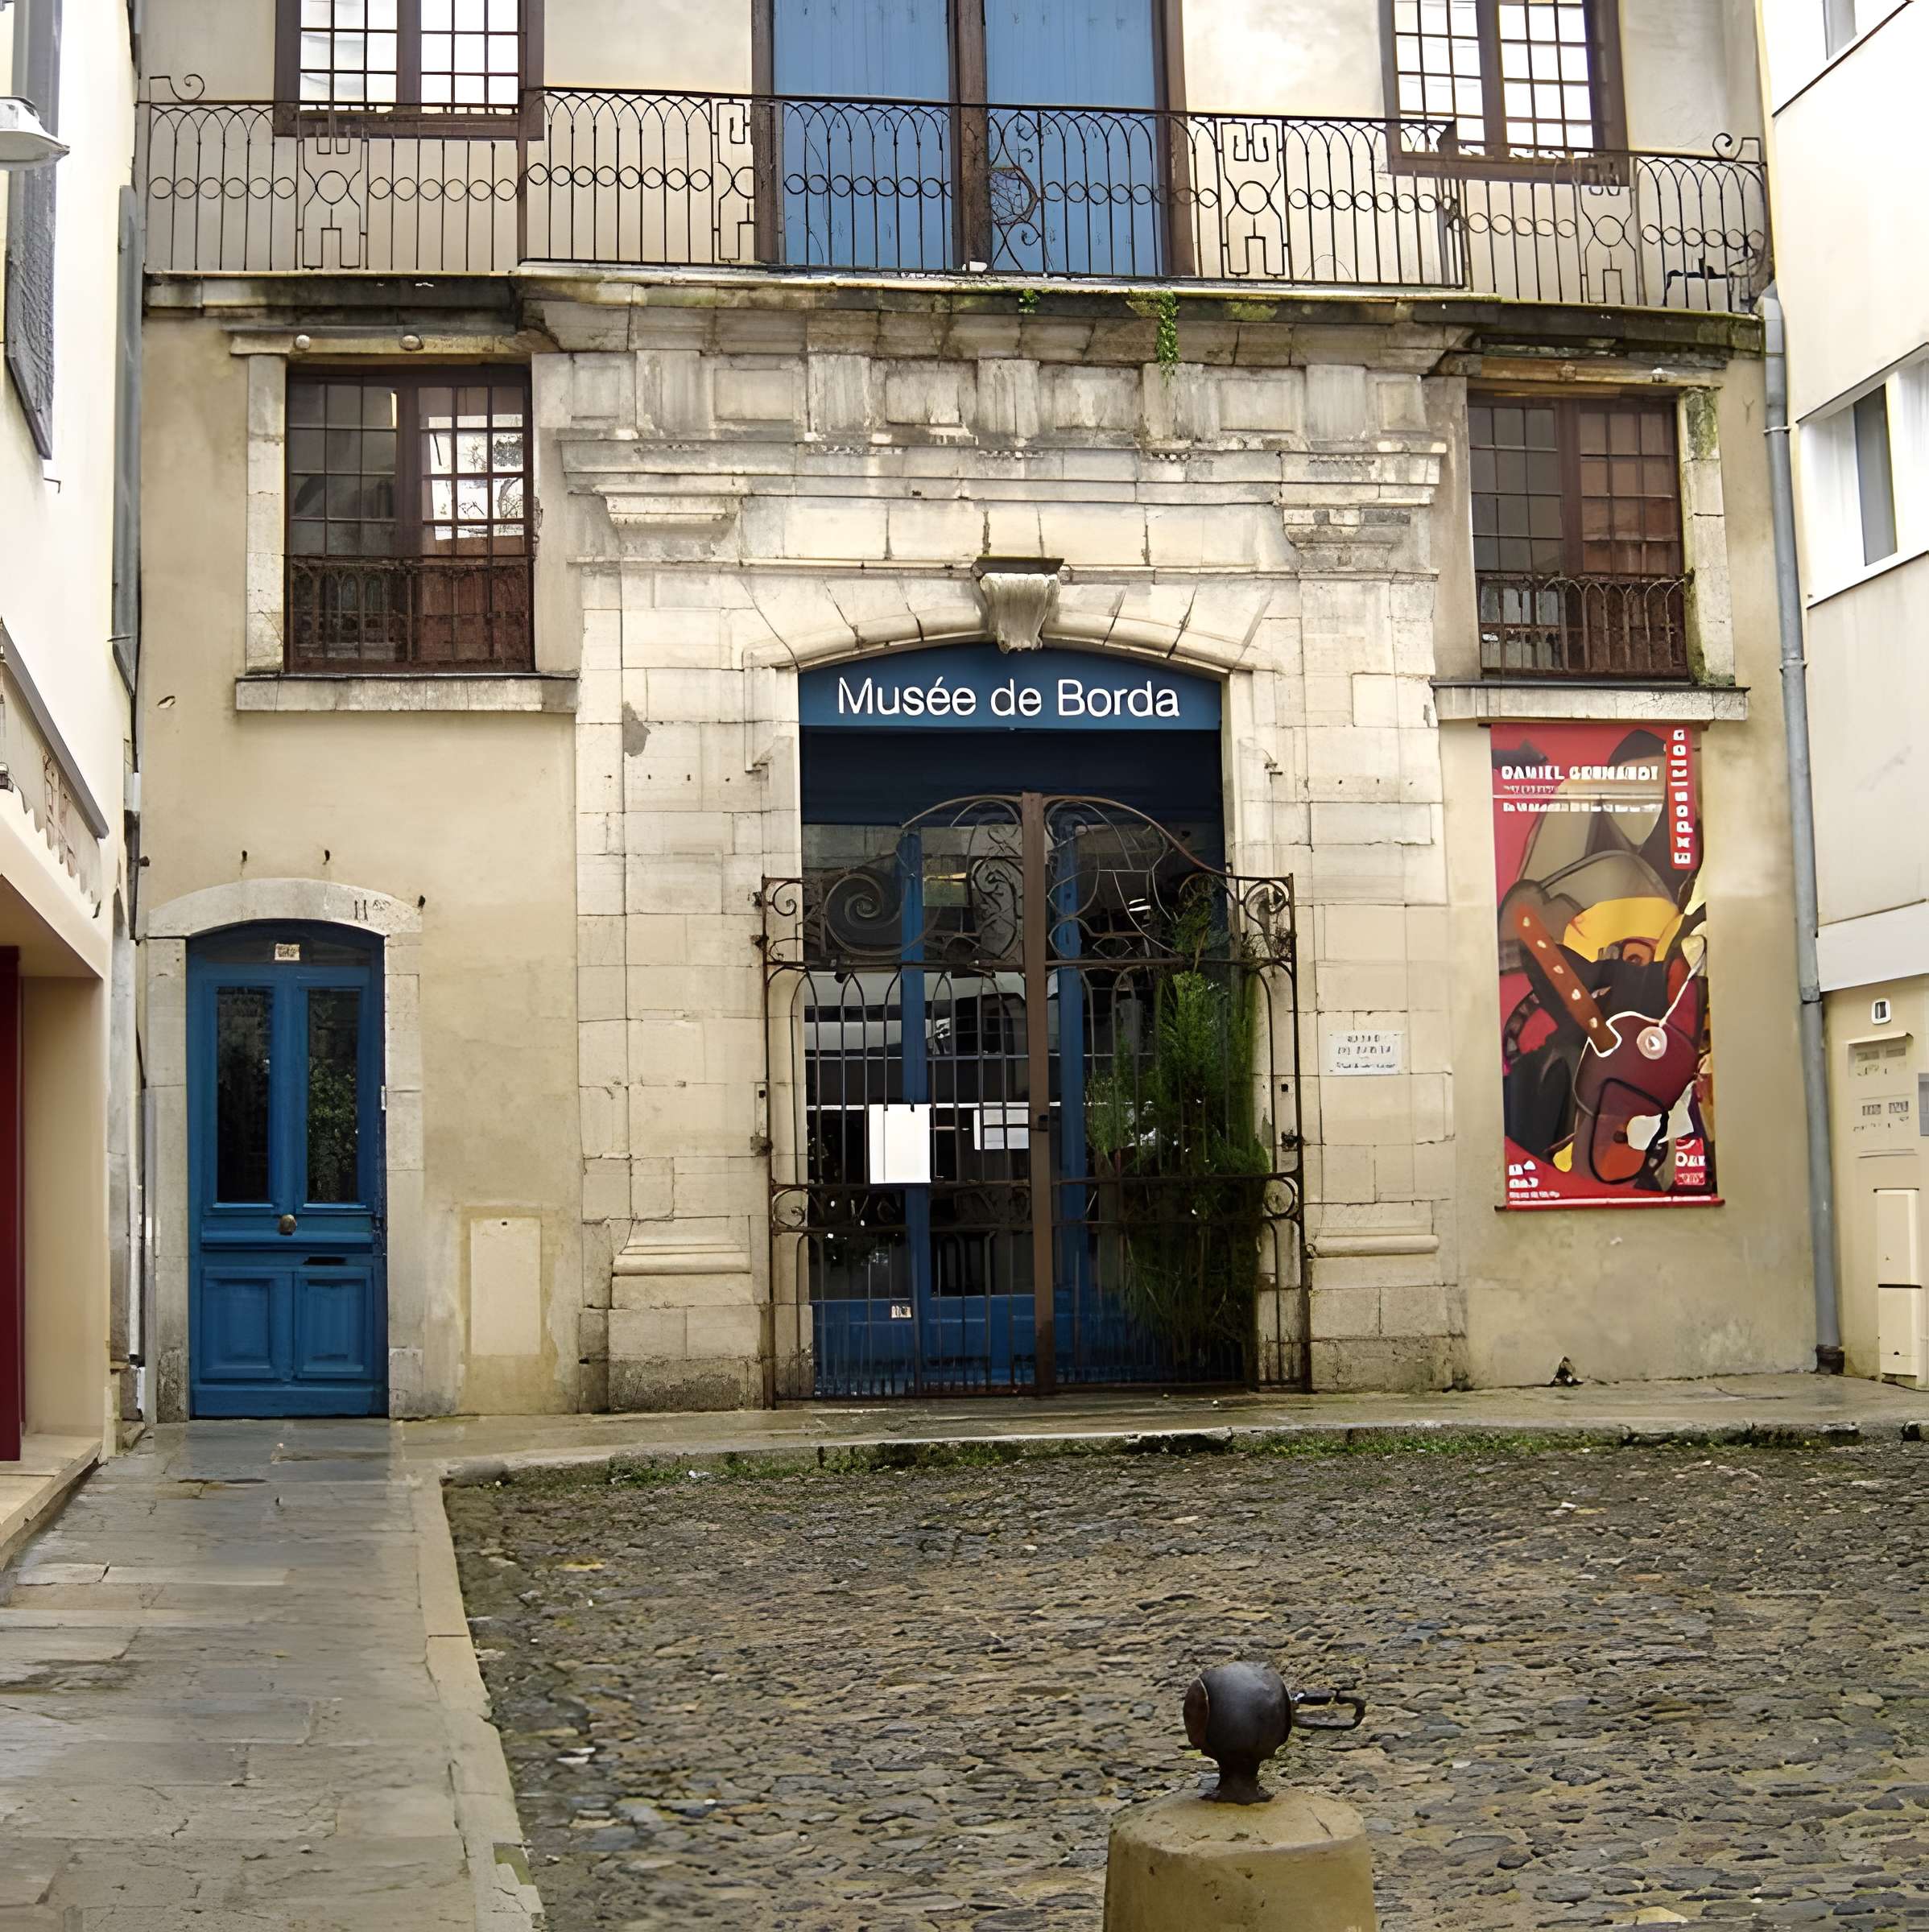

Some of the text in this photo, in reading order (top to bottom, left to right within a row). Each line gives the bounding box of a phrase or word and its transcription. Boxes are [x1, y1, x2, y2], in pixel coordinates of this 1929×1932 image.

[838, 676, 1180, 717] Musée de Borda
